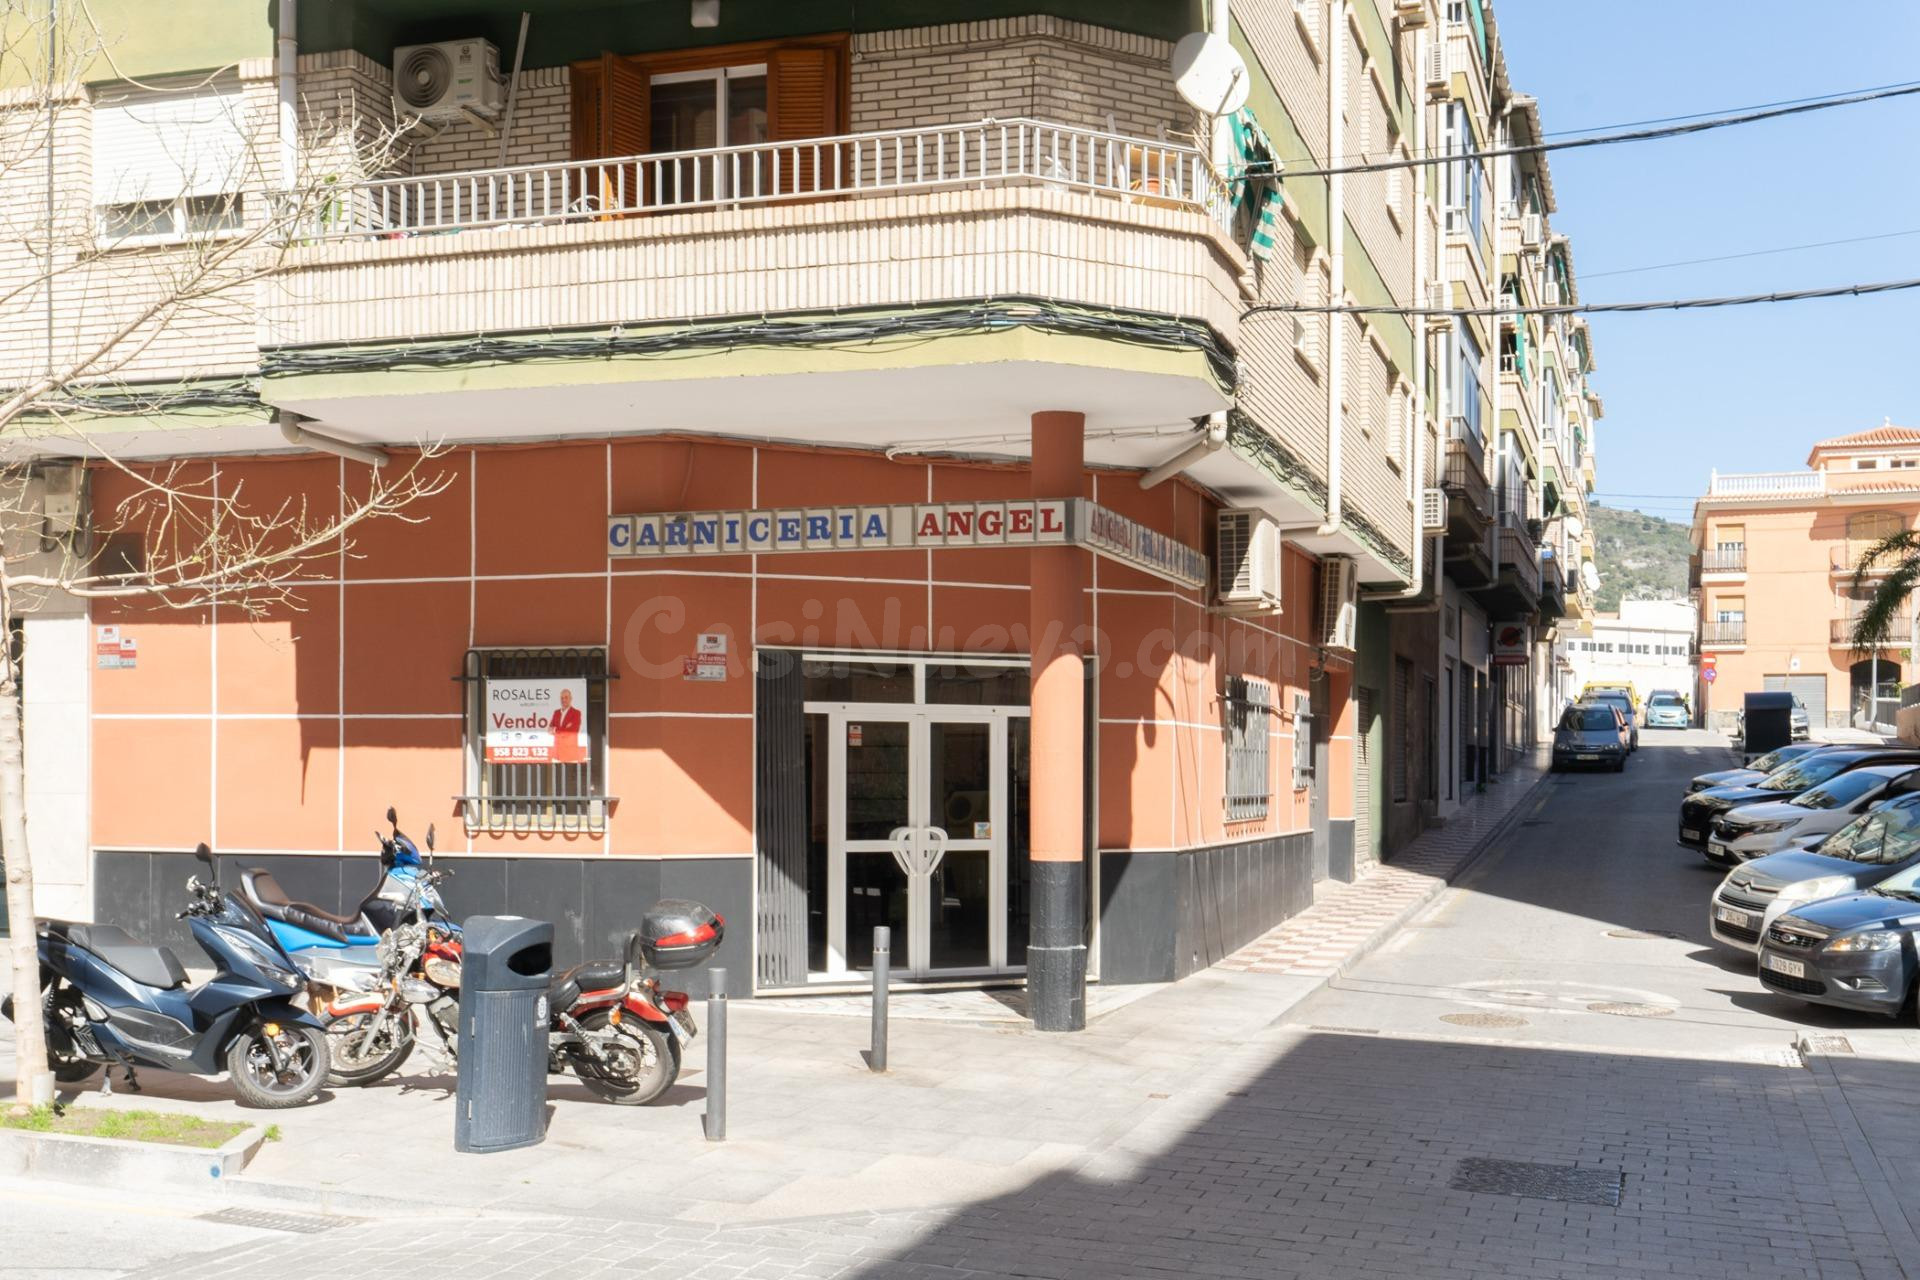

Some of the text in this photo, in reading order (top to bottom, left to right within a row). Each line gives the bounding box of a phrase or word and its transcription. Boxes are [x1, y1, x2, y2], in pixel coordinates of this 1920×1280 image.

[609, 508, 1063, 547] CARNICERIA ANGEL
[492, 688, 551, 701] ROSALES
[492, 712, 548, 729] Vendo
